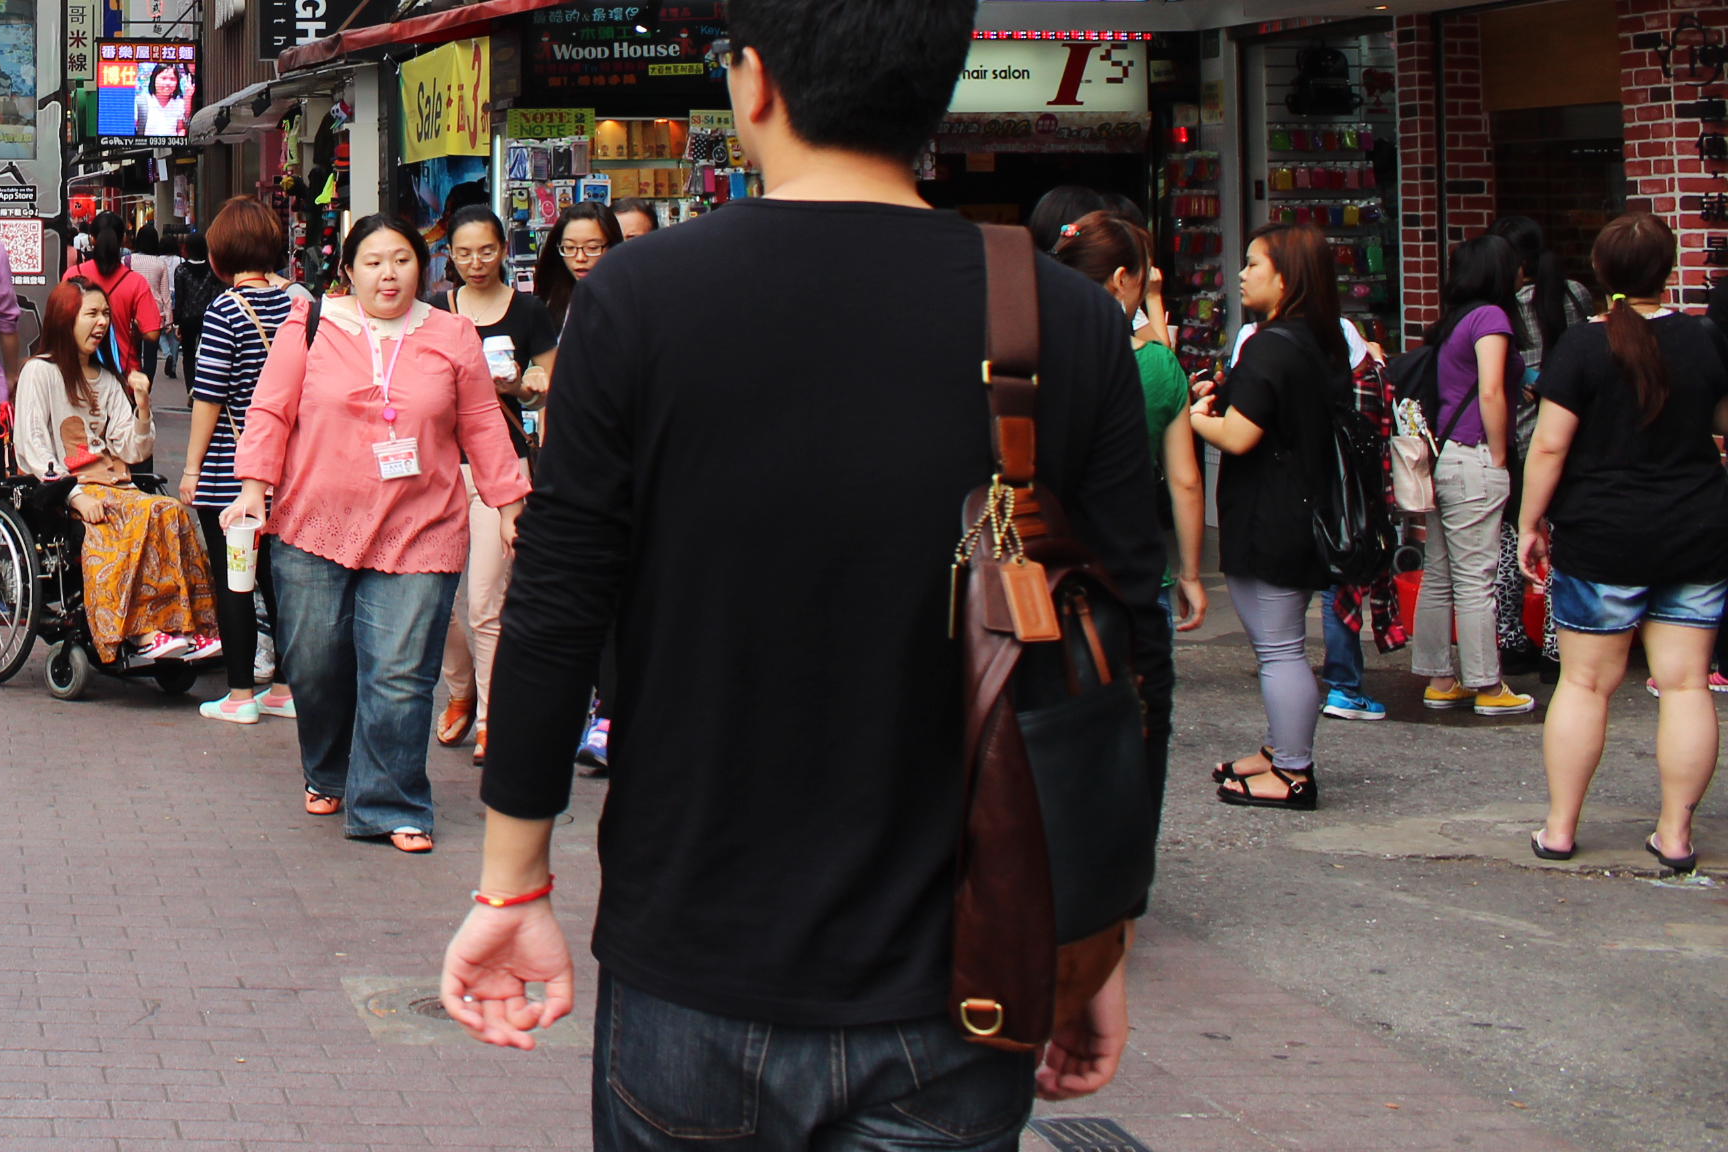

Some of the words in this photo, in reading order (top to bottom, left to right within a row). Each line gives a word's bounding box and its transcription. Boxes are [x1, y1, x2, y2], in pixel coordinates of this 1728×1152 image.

[992, 65, 1030, 80] salon
[416, 77, 443, 144] Sale
[519, 111, 573, 124] NOTE
[574, 112, 586, 124] 2
[519, 124, 565, 136] NOTE
[574, 124, 586, 136] 3
[982, 119, 1031, 138] 980
[149, 137, 166, 146] 0939
[14, 192, 34, 200] Store
